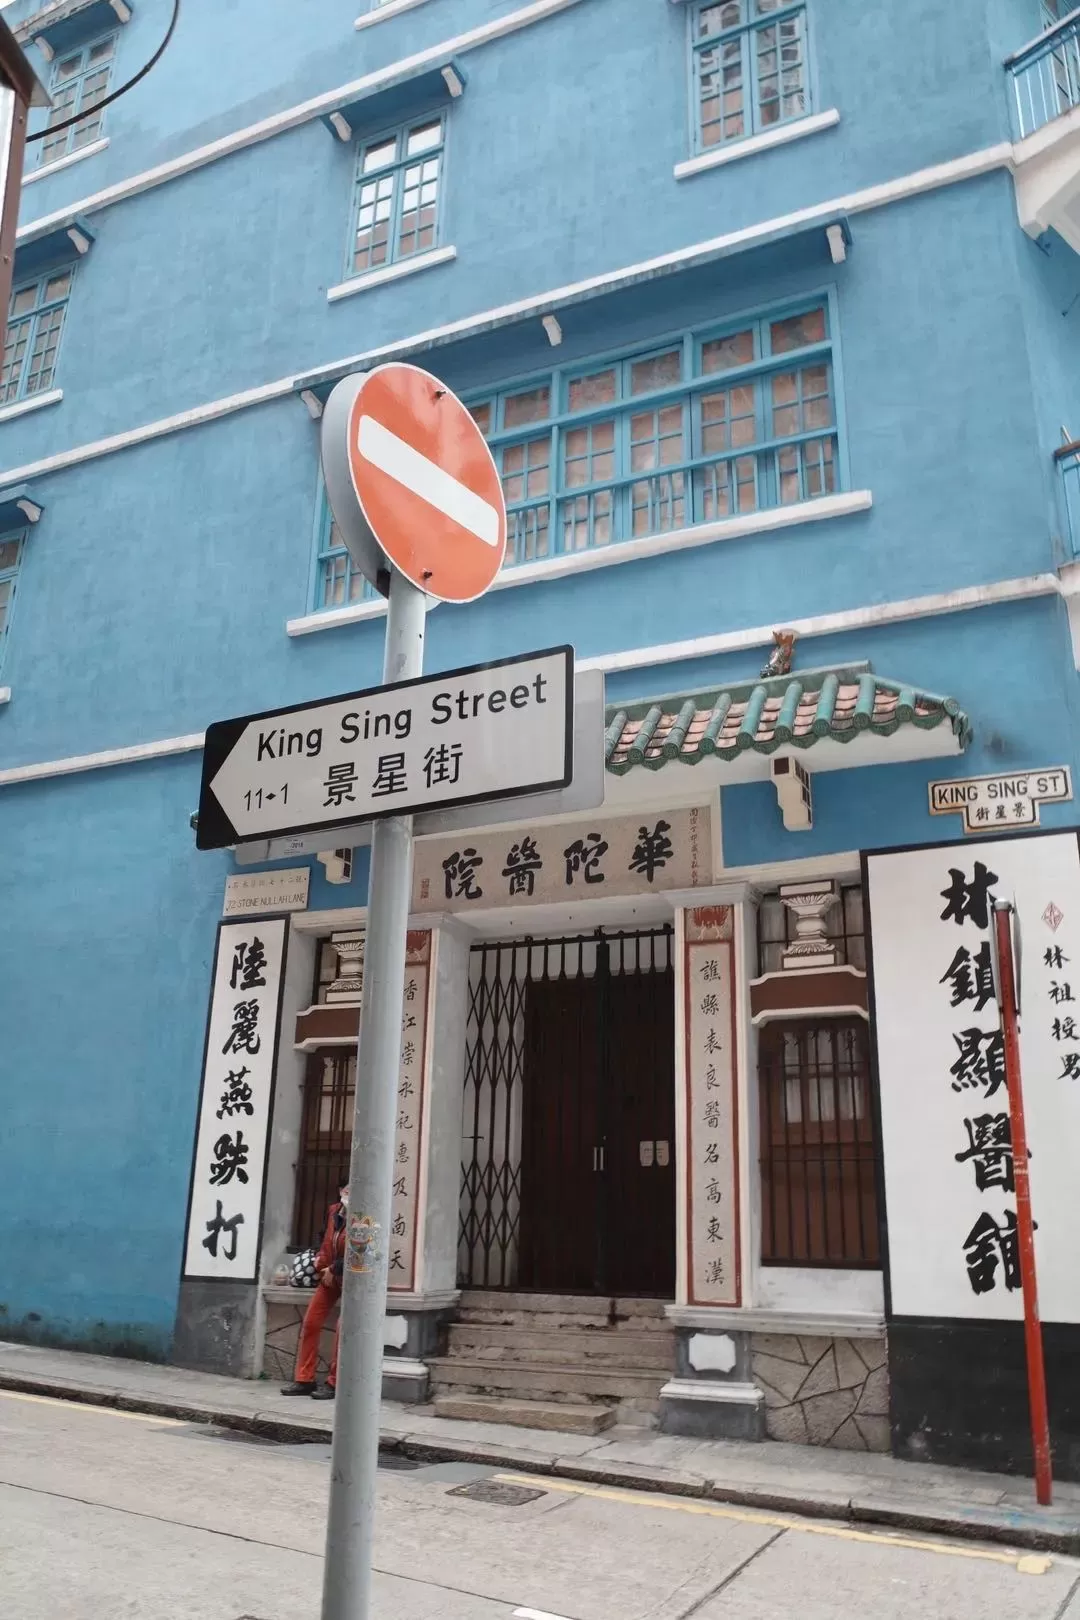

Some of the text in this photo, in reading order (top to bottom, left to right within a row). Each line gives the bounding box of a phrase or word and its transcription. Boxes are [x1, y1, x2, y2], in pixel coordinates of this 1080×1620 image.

[257, 673, 547, 762] King Sing Street
[322, 743, 464, 808] 景星街
[938, 775, 1060, 804] KING SING ST
[237, 897, 259, 908] STONE
[260, 895, 288, 906] NULLAH
[289, 892, 305, 904] LANE
